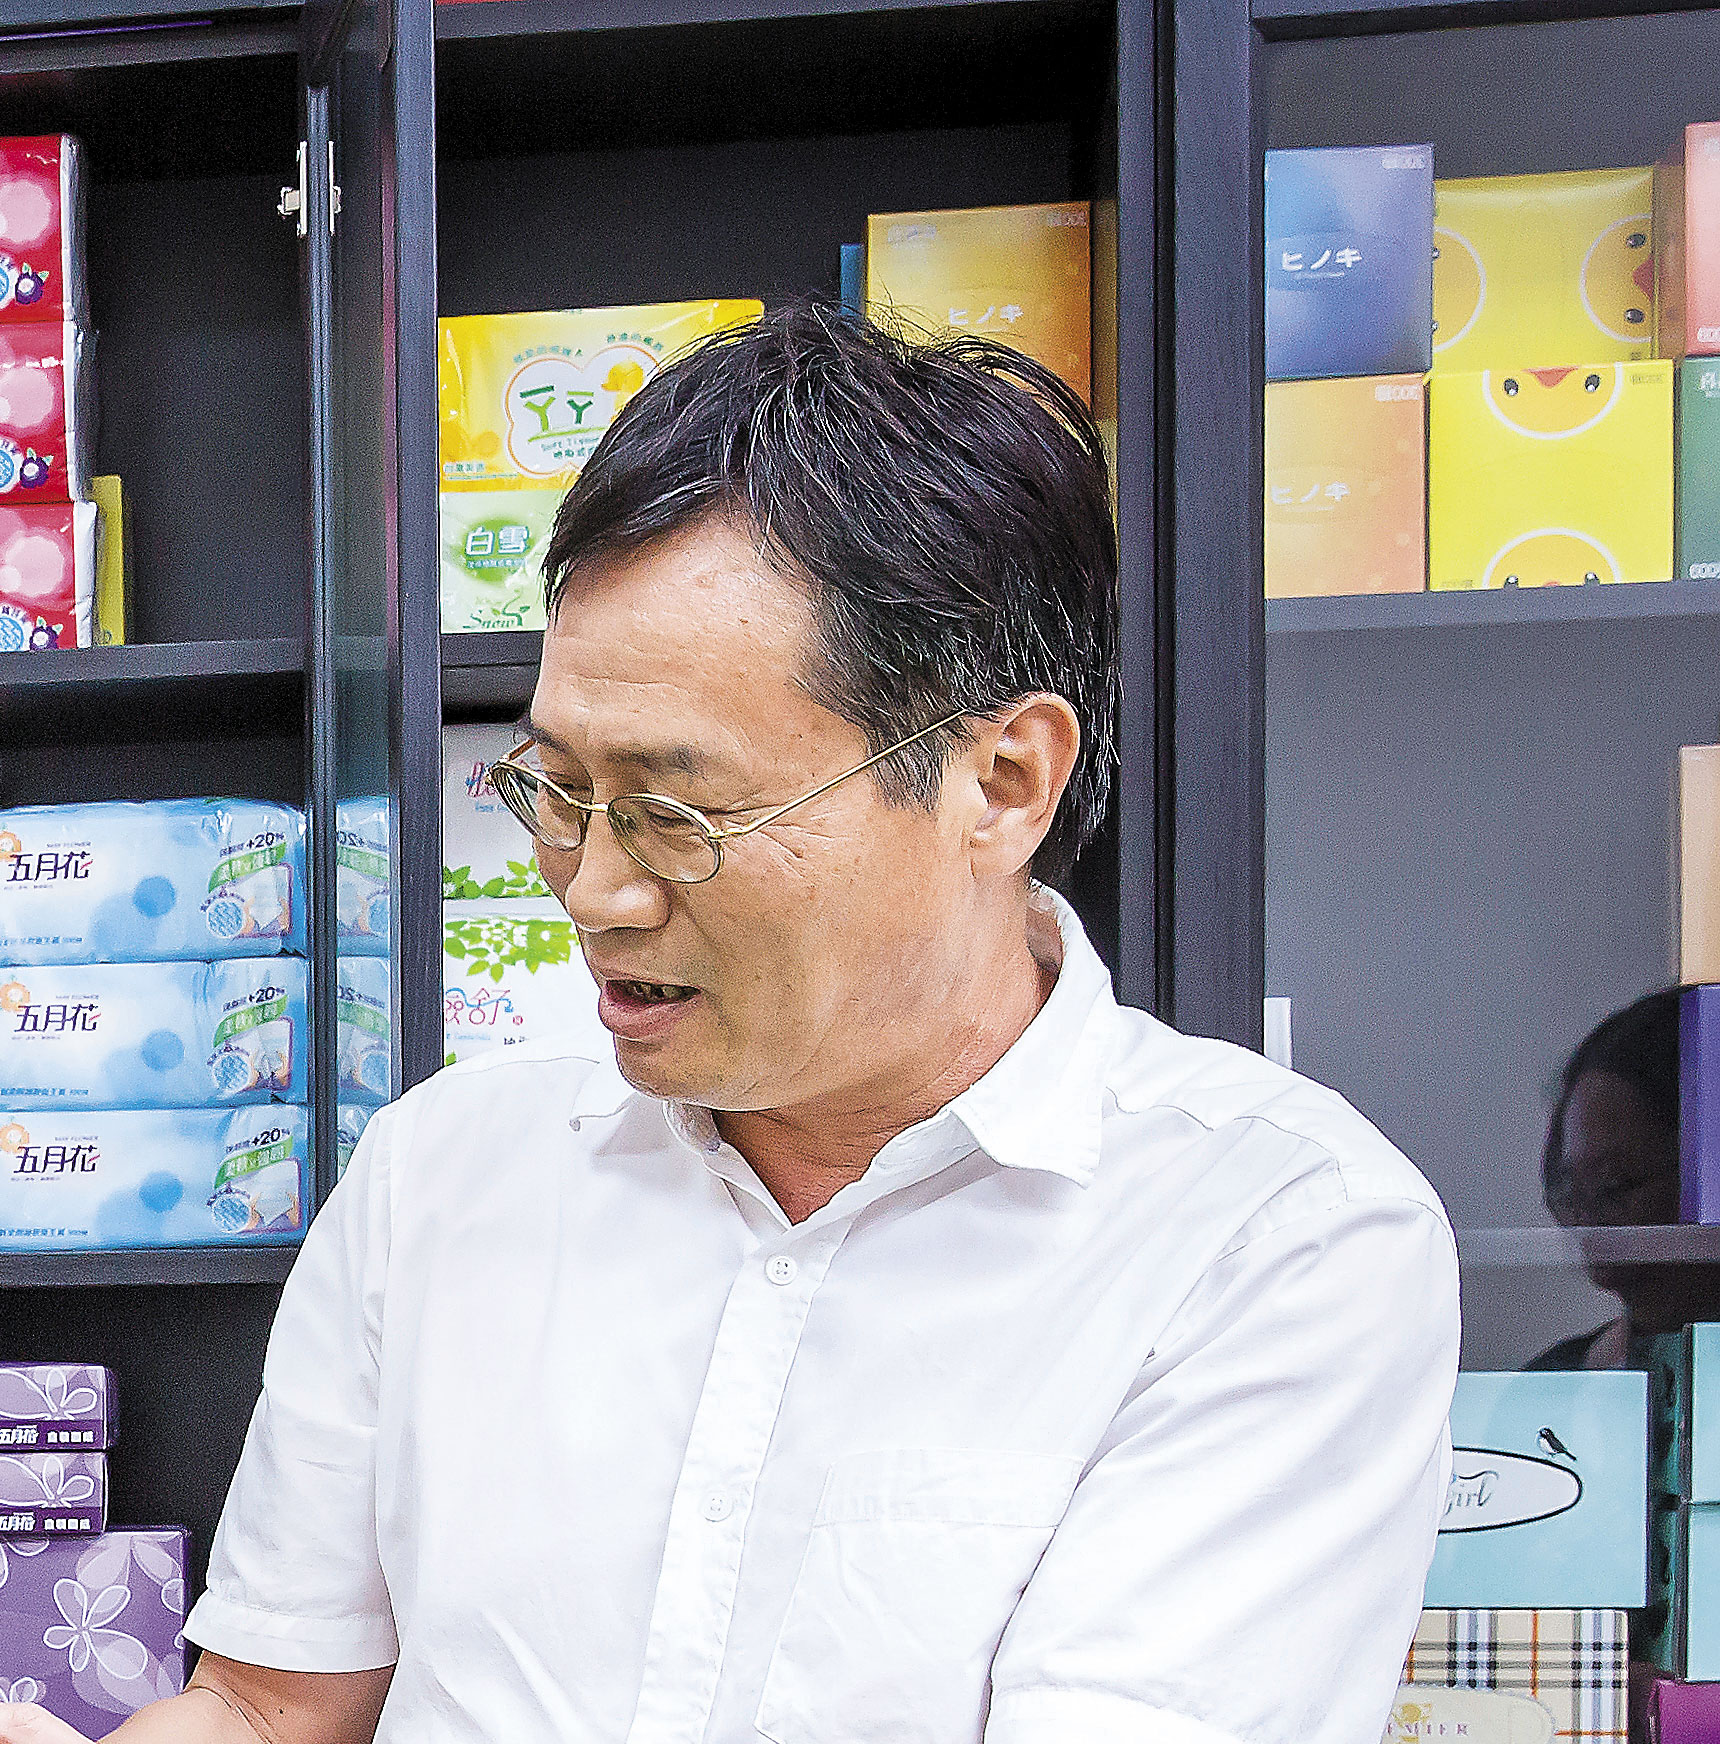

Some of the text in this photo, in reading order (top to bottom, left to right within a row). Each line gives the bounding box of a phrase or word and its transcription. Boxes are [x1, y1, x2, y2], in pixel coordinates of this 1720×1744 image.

[1282, 248, 1362, 271] ヒノキ
[948, 305, 1024, 325] ヒノキ
[1271, 483, 1350, 503] ヒノキ
[465, 525, 530, 557] 白雪
[6, 851, 93, 882] 五月花
[13, 1002, 101, 1033] 五月花
[14, 1145, 100, 1174] 五月花
